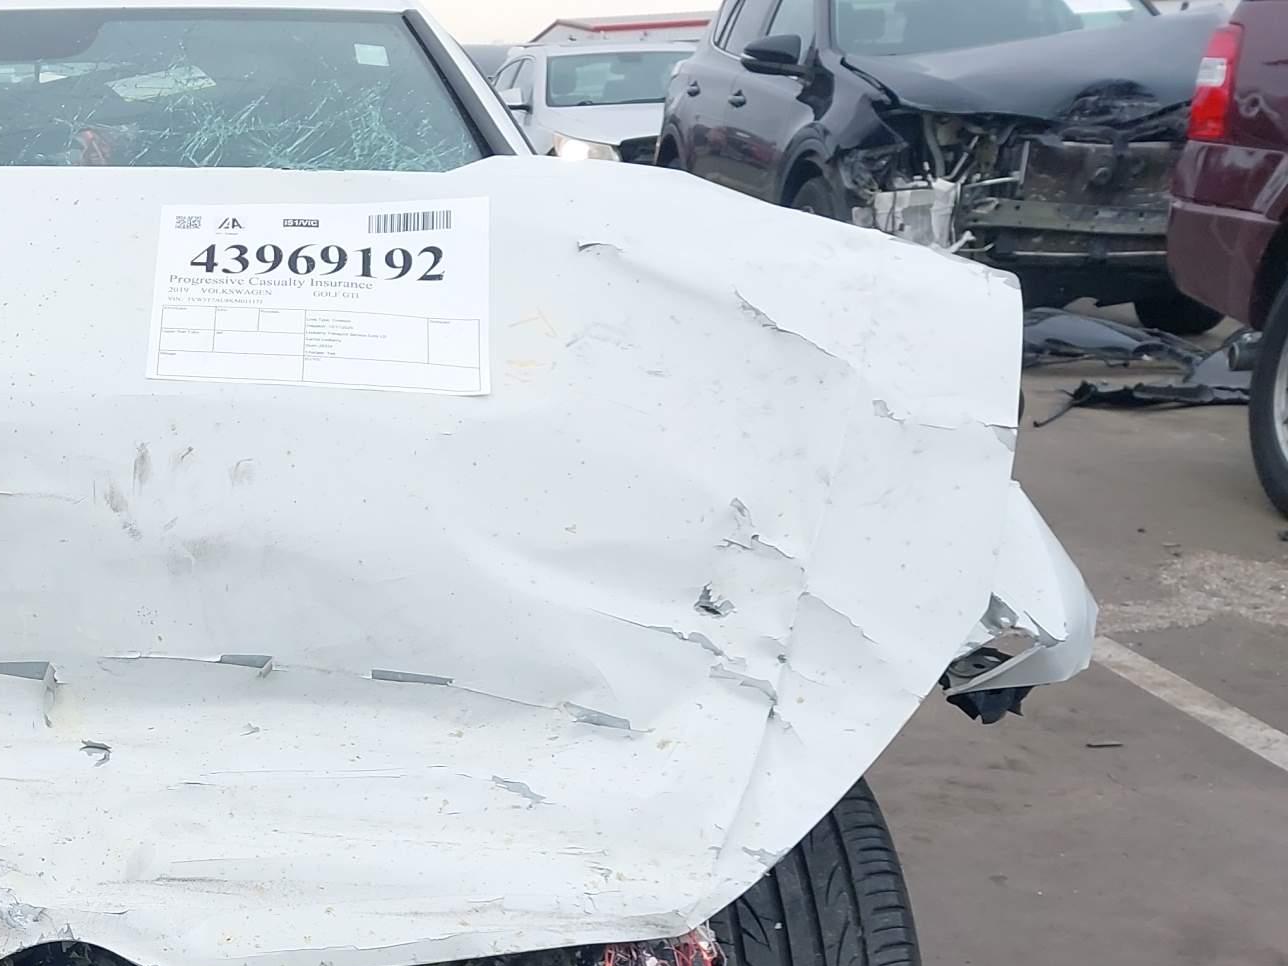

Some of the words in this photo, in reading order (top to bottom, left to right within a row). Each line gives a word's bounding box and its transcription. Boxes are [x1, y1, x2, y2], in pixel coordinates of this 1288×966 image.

[190, 243, 446, 281] 43969192
[169, 274, 245, 286] Progressive
[248, 276, 306, 289] Casualty
[310, 278, 374, 290] Insurance
[201, 287, 273, 296] VOLKSWAGEN
[313, 290, 339, 298] GOLF
